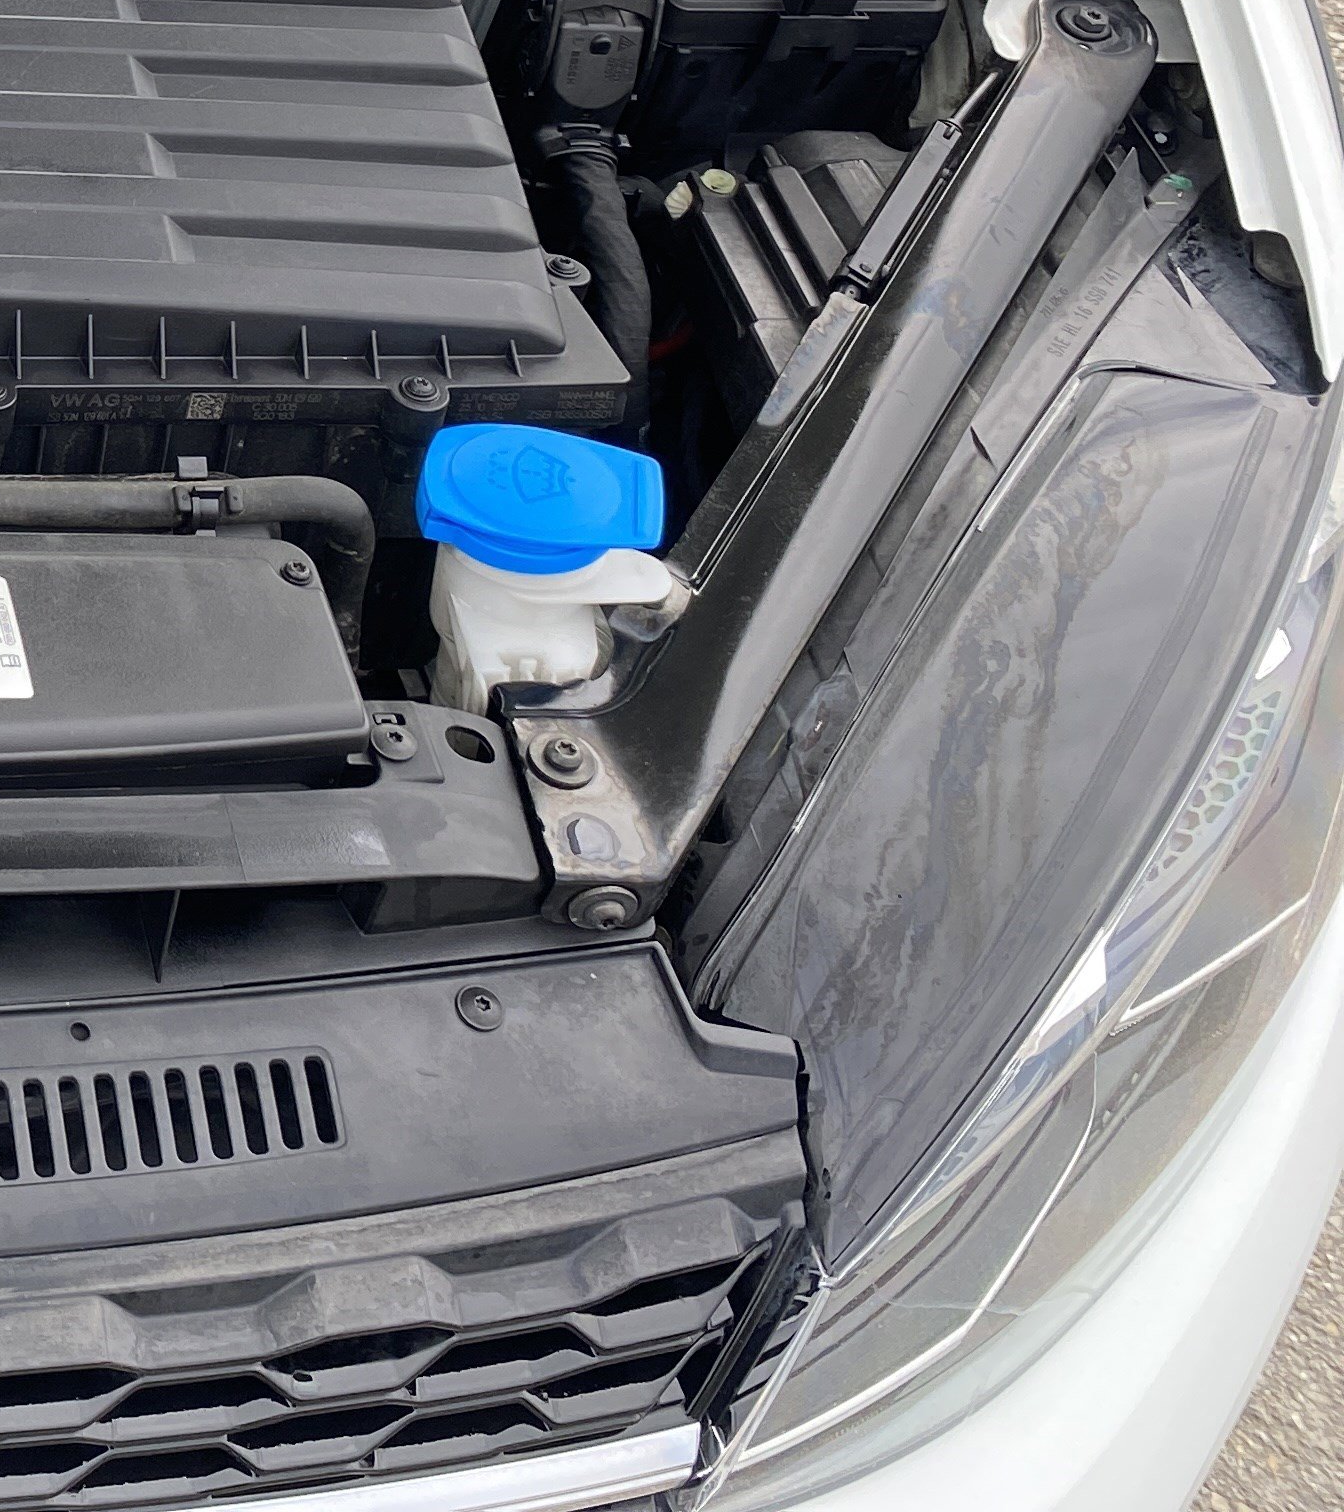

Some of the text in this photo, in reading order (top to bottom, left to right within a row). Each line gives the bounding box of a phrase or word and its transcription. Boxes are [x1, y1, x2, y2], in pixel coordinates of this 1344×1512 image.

[1073, 306, 1093, 319] 16
[50, 393, 85, 408] VW
[87, 393, 120, 407] AG
[252, 403, 261, 411] C
